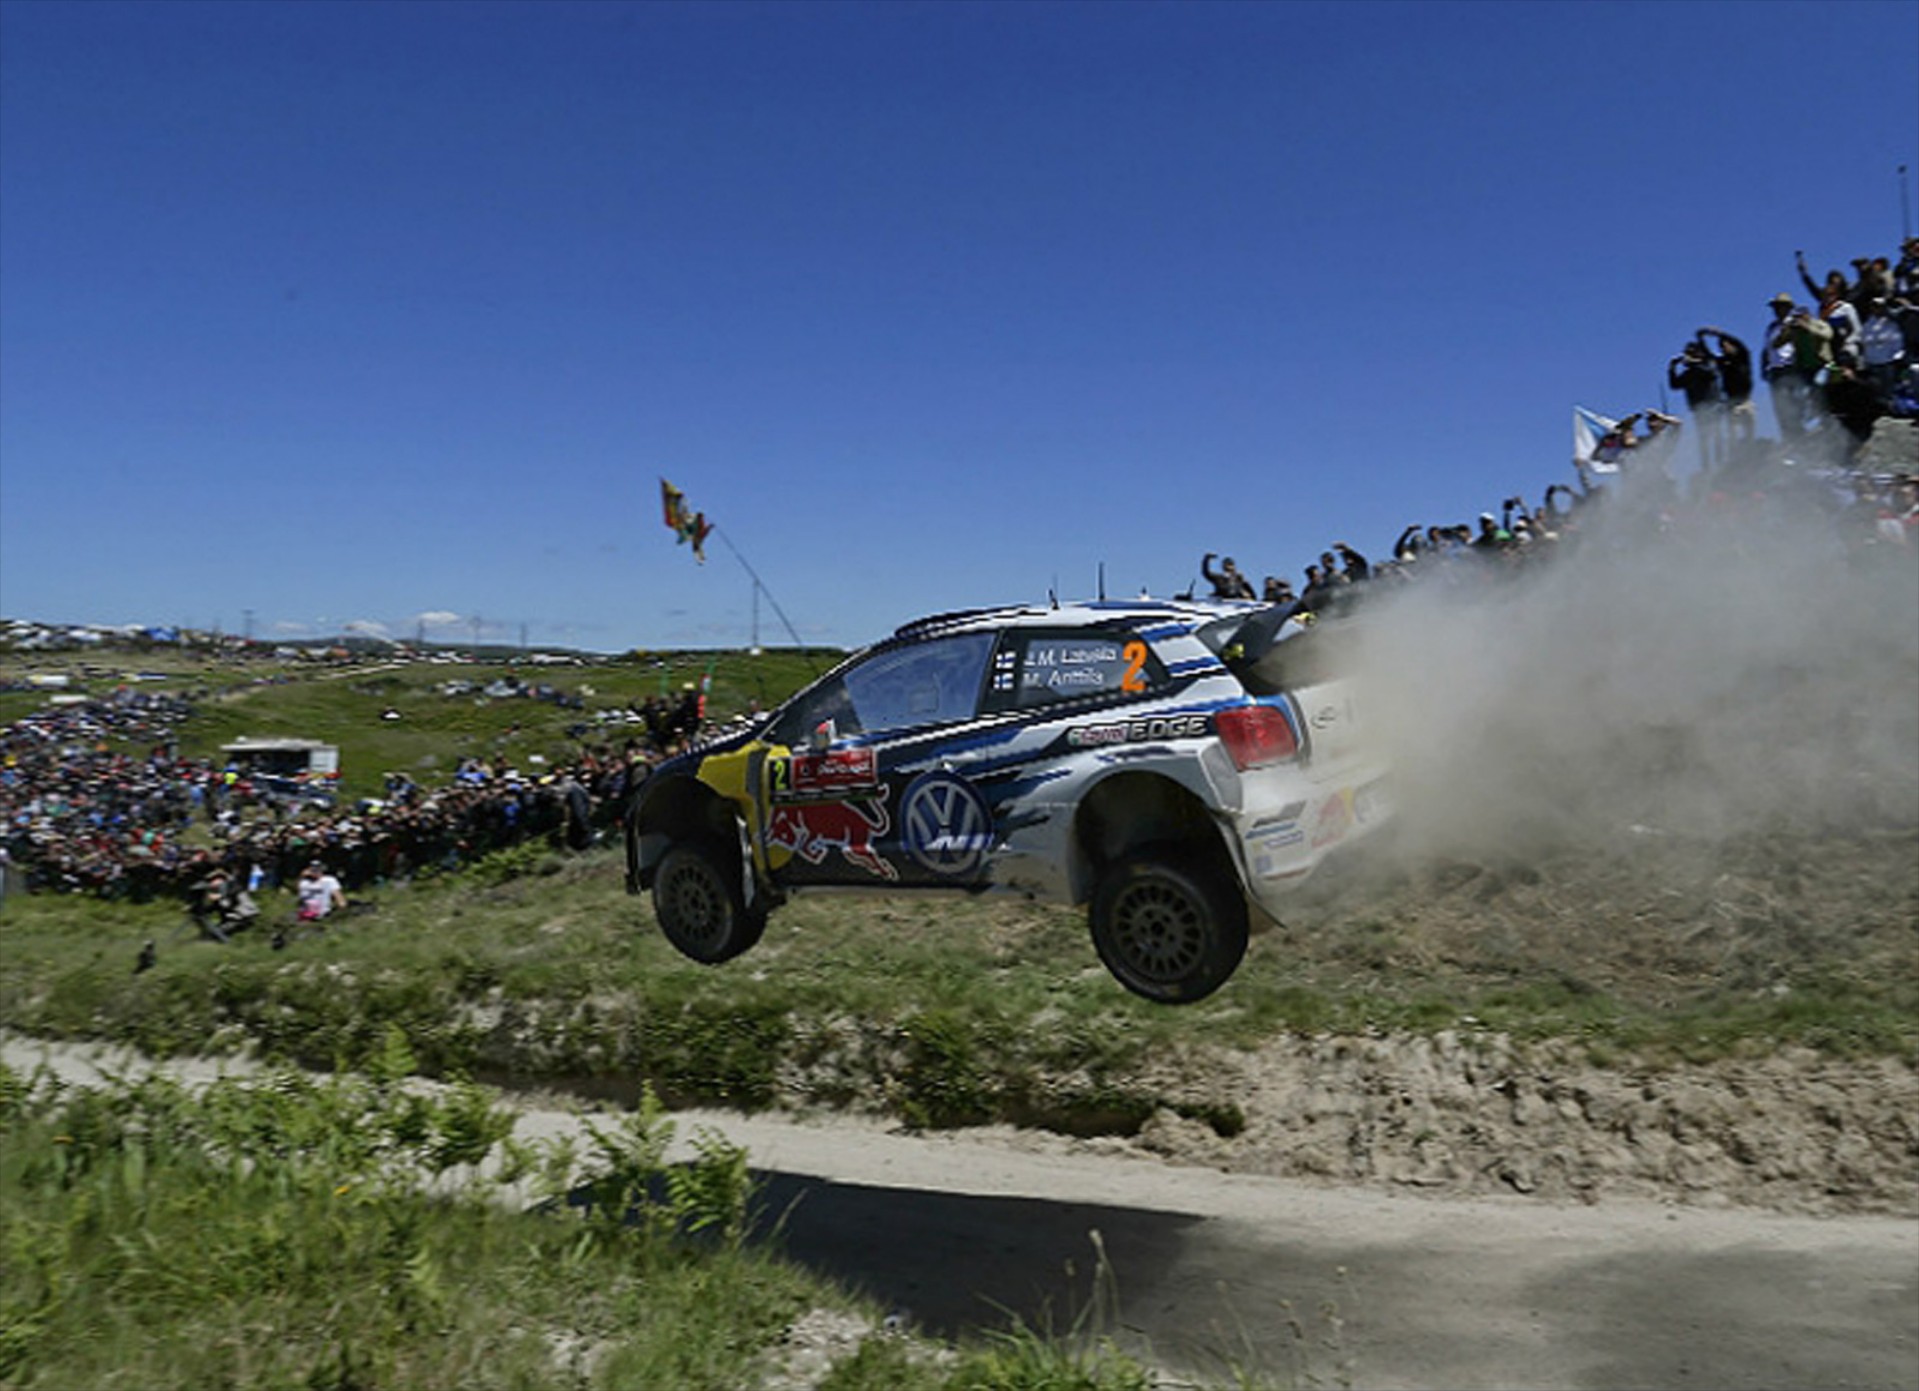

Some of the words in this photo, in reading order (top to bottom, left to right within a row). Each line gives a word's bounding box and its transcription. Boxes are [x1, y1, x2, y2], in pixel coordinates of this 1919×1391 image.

[1121, 640, 1148, 691] 2
[1130, 716, 1208, 741] EDGE
[773, 760, 788, 791] 2
